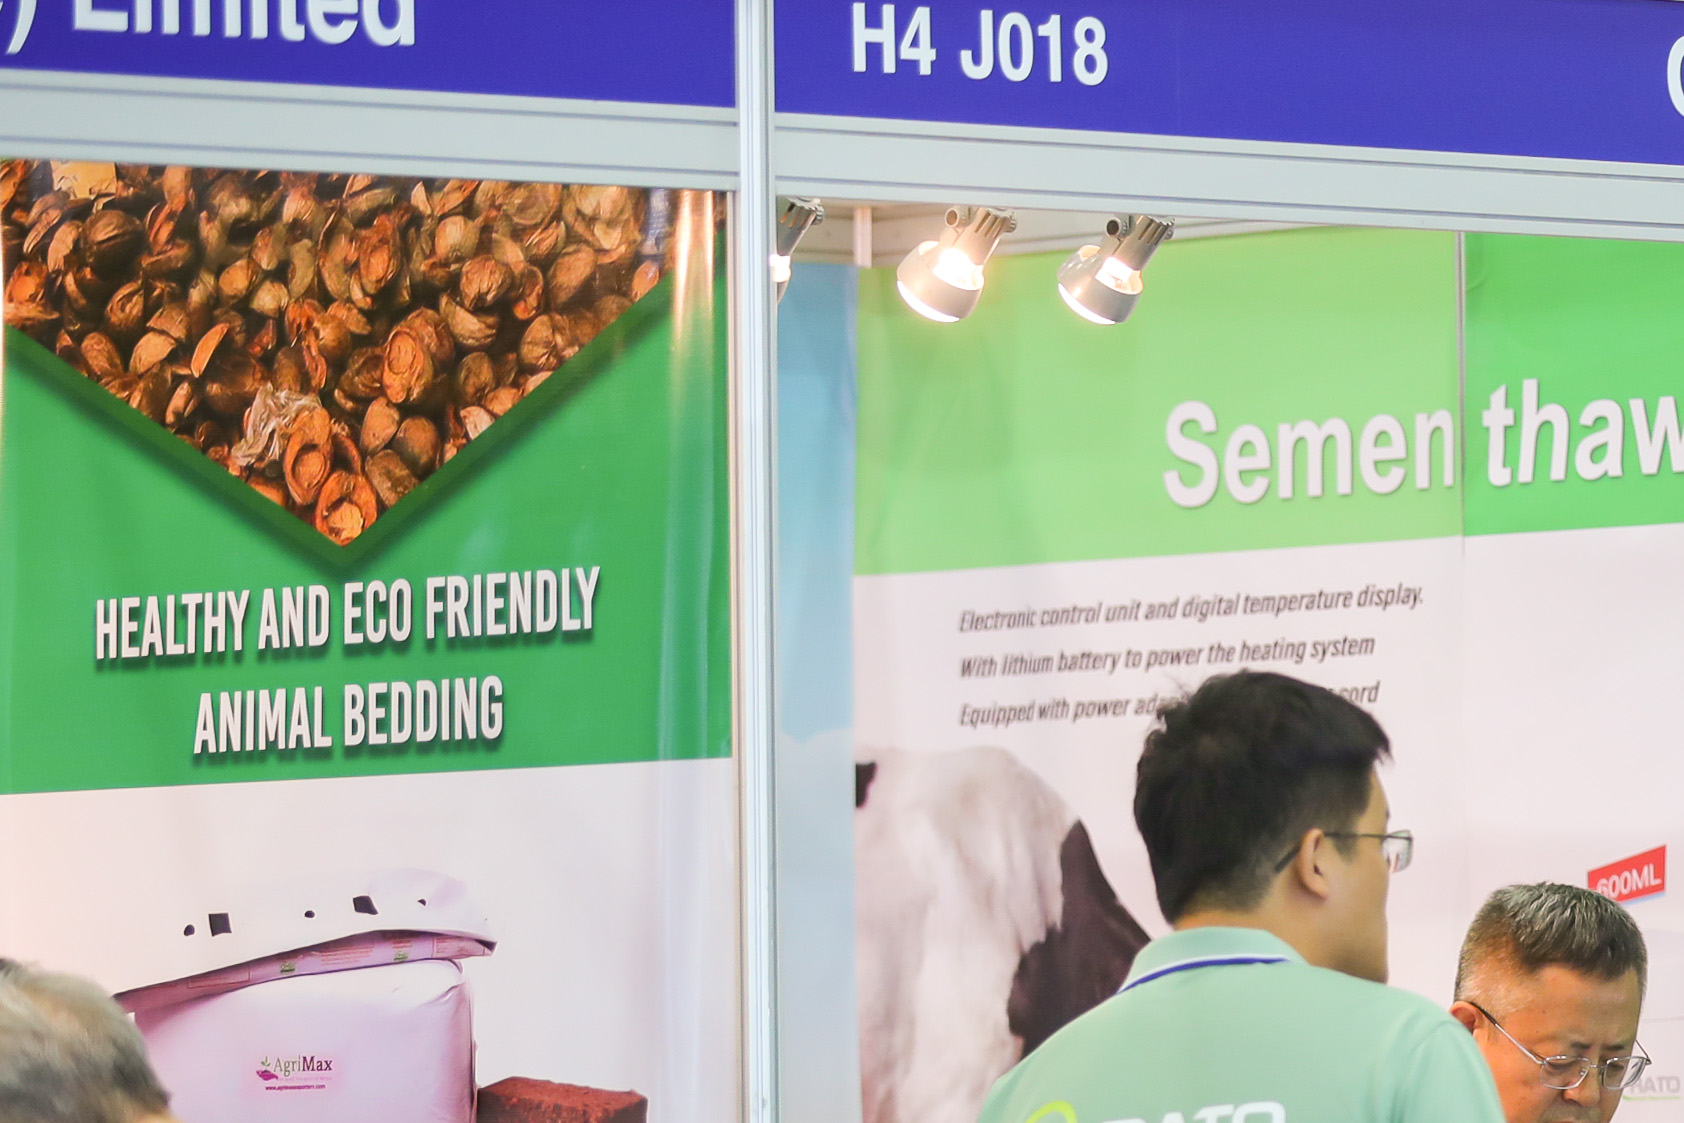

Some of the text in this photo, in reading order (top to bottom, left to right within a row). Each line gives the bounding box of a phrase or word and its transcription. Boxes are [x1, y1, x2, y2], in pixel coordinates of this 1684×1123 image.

[852, 2, 1109, 86] H4 J018
[1163, 400, 1455, 508] Semen
[95, 566, 601, 660] HEALTHY AND ECO FRIENDLY
[959, 606, 1037, 633] Electronic
[1040, 602, 1103, 626] control
[1105, 598, 1142, 622] unit
[1145, 596, 1181, 620] and
[1182, 592, 1241, 623] digital
[1243, 589, 1354, 618] temperature
[961, 635, 1376, 678] With lithium battery to power the heating system
[193, 675, 504, 754] ANIMAL BEDDING
[960, 701, 1035, 730] Equipped
[1039, 698, 1070, 721] with
[1073, 698, 1130, 723] power
[1596, 863, 1662, 899] 600ML
[274, 1054, 333, 1078] AgriMax
